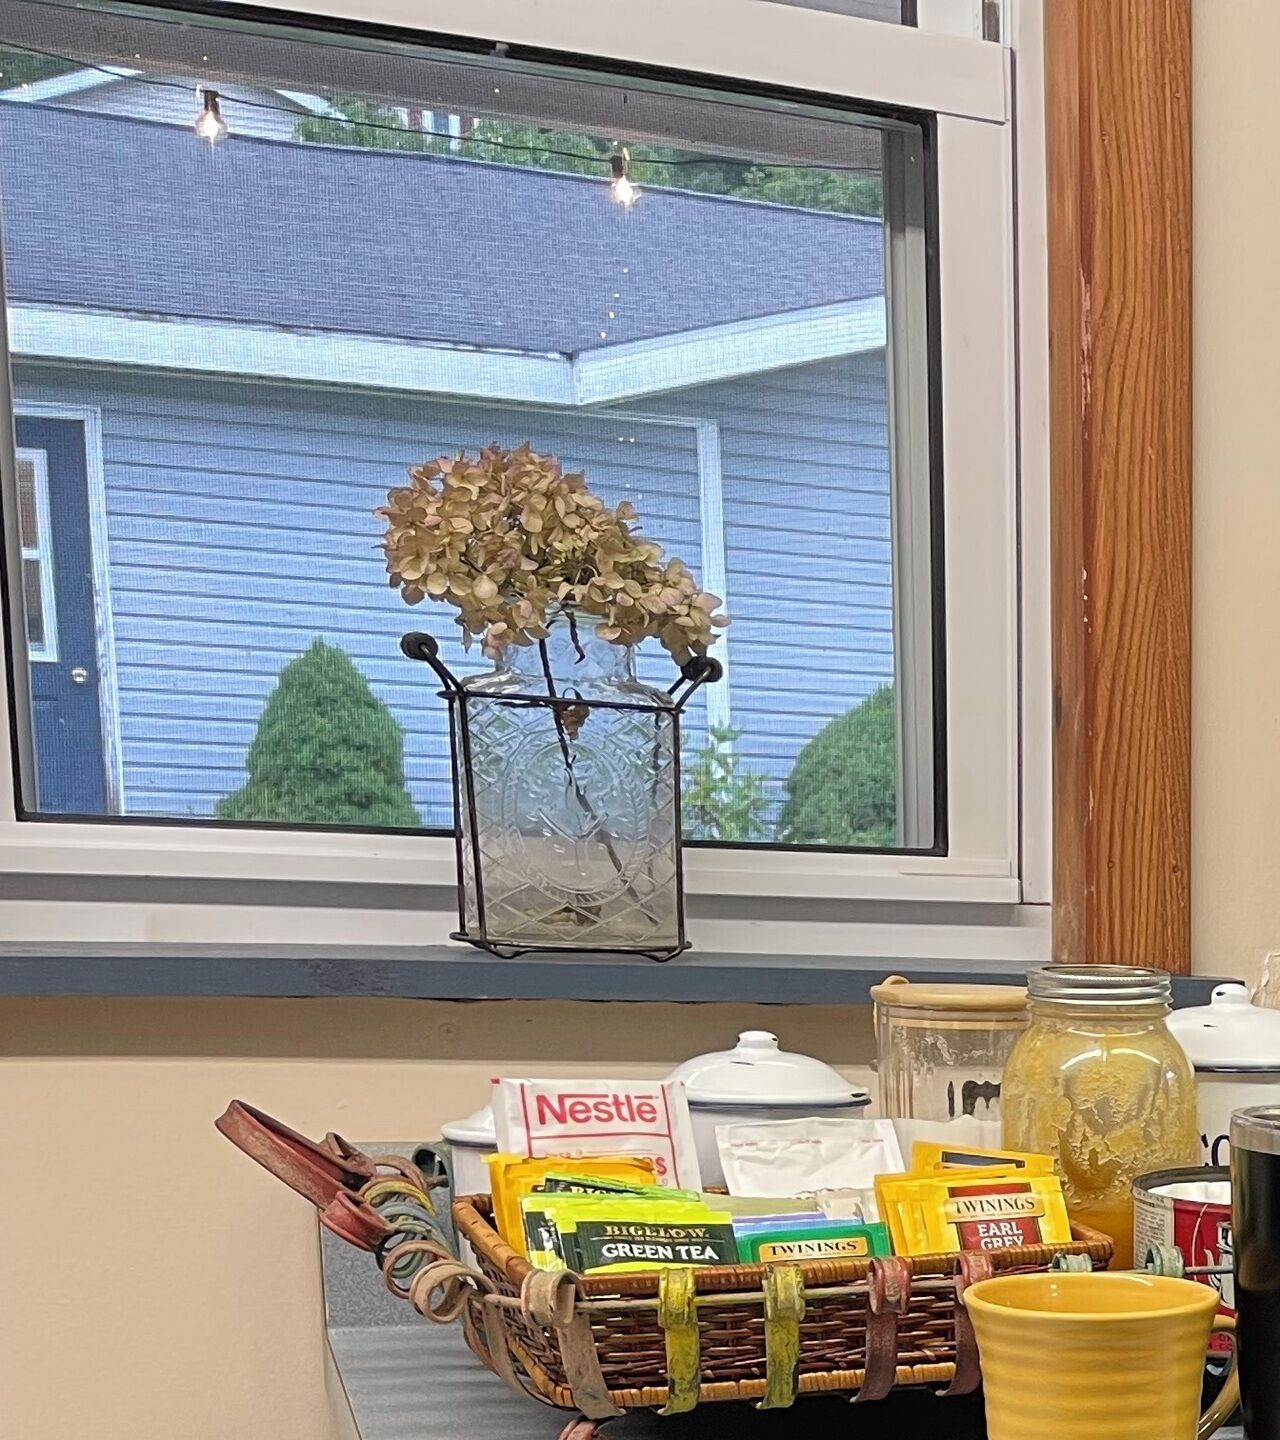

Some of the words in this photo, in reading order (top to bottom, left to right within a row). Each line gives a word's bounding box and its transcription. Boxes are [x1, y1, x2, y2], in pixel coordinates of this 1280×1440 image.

[954, 1197, 1035, 1214] TWININGS
[602, 1224, 708, 1238] BIGELOW
[978, 1221, 1022, 1237] EARL
[602, 1243, 673, 1260] GREEN
[675, 1246, 720, 1260] TEA
[769, 1240, 857, 1256] TWININGS
